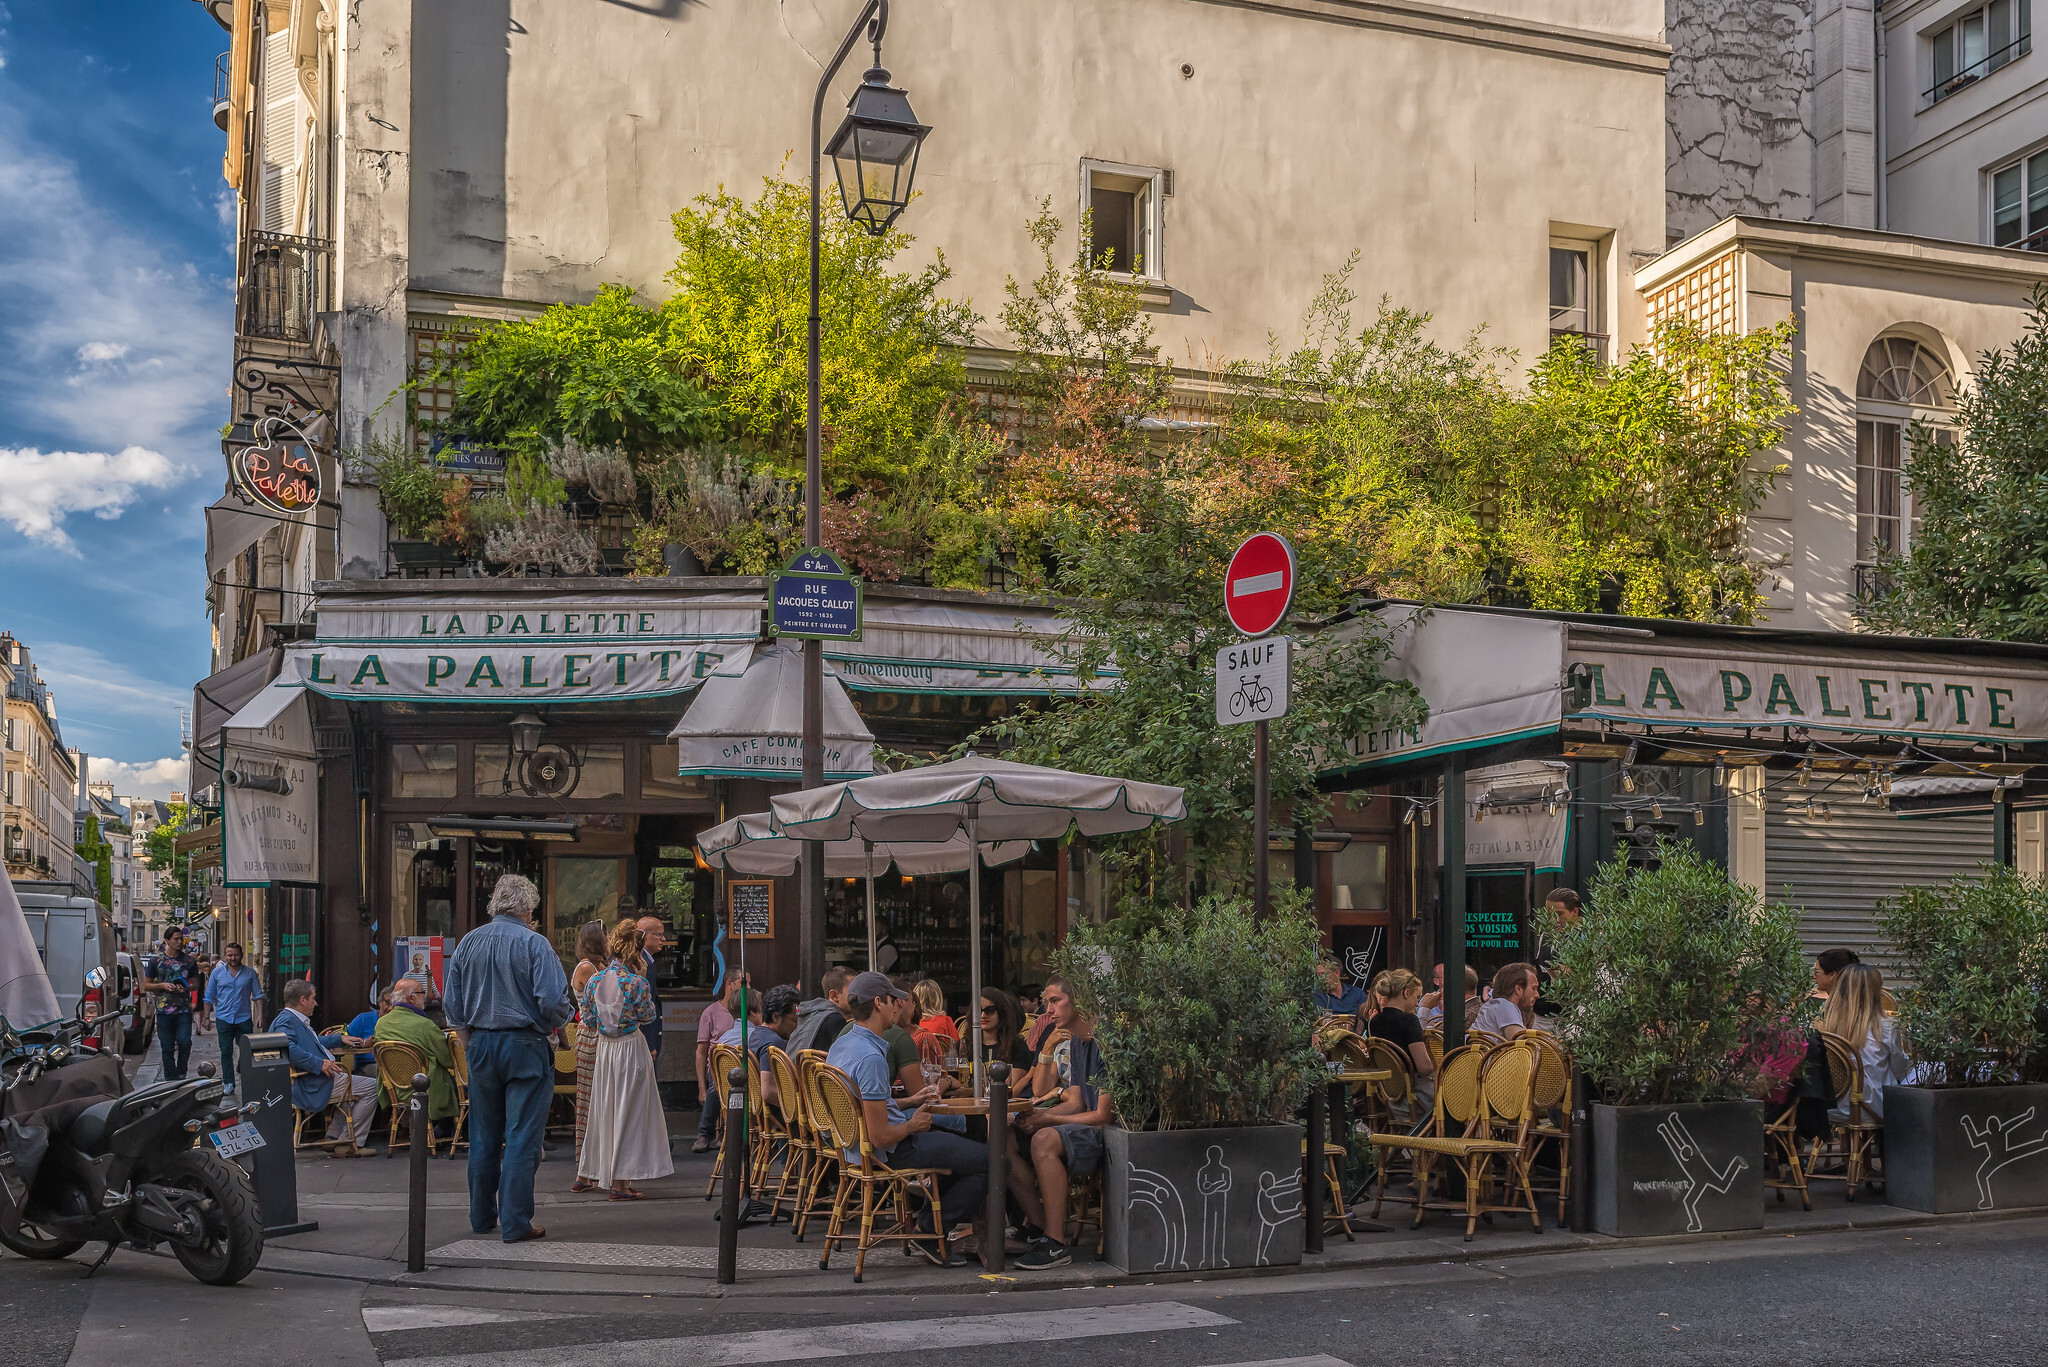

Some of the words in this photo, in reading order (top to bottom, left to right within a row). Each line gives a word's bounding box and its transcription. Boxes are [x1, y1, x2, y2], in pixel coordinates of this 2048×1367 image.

[248, 453, 317, 503] Palette
[804, 584, 828, 595] RUE
[777, 597, 820, 608] JACQUES
[821, 599, 854, 610] CALLOT
[420, 614, 466, 635] LA
[486, 612, 656, 635] PALETTE
[1228, 643, 1275, 671] SAUF
[308, 653, 390, 687] LA
[424, 650, 725, 689] PALETTE
[1591, 663, 1685, 711] LA
[1718, 669, 2017, 730] PALETTE
[722, 738, 759, 758] CAFE
[745, 755, 787, 767] DEPUIS
[791, 757, 803, 767] 19
[1465, 923, 1476, 934] OS
[1478, 923, 1518, 934] VOISINS
[1465, 939, 1479, 948] RCI
[1480, 939, 1502, 948] POUR
[1504, 940, 1520, 948] EUX
